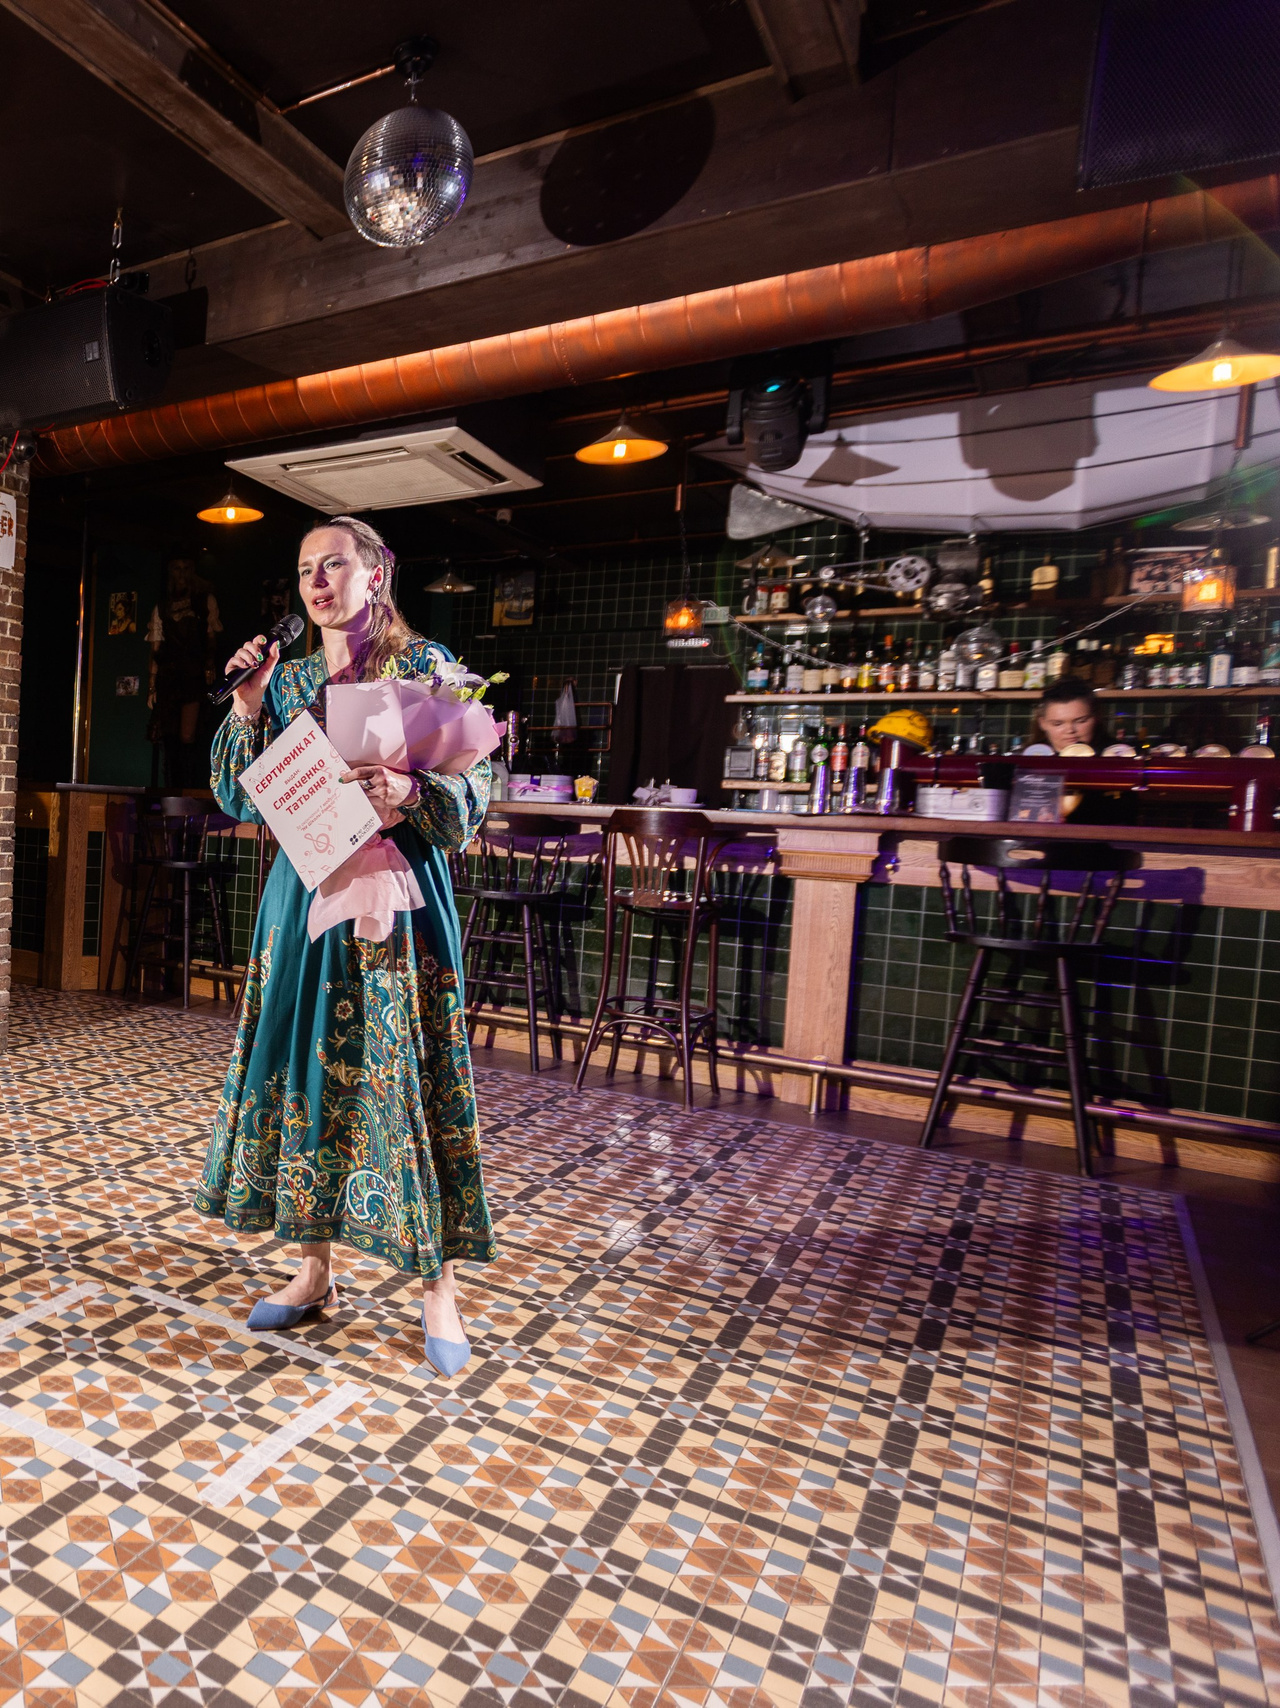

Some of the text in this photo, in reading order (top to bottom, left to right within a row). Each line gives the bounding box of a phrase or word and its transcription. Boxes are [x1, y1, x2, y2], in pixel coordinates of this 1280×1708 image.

[255, 730, 317, 794] СЕРТИФИКАТ
[273, 759, 325, 810] Славченко
[285, 776, 327, 815] Татьяне
